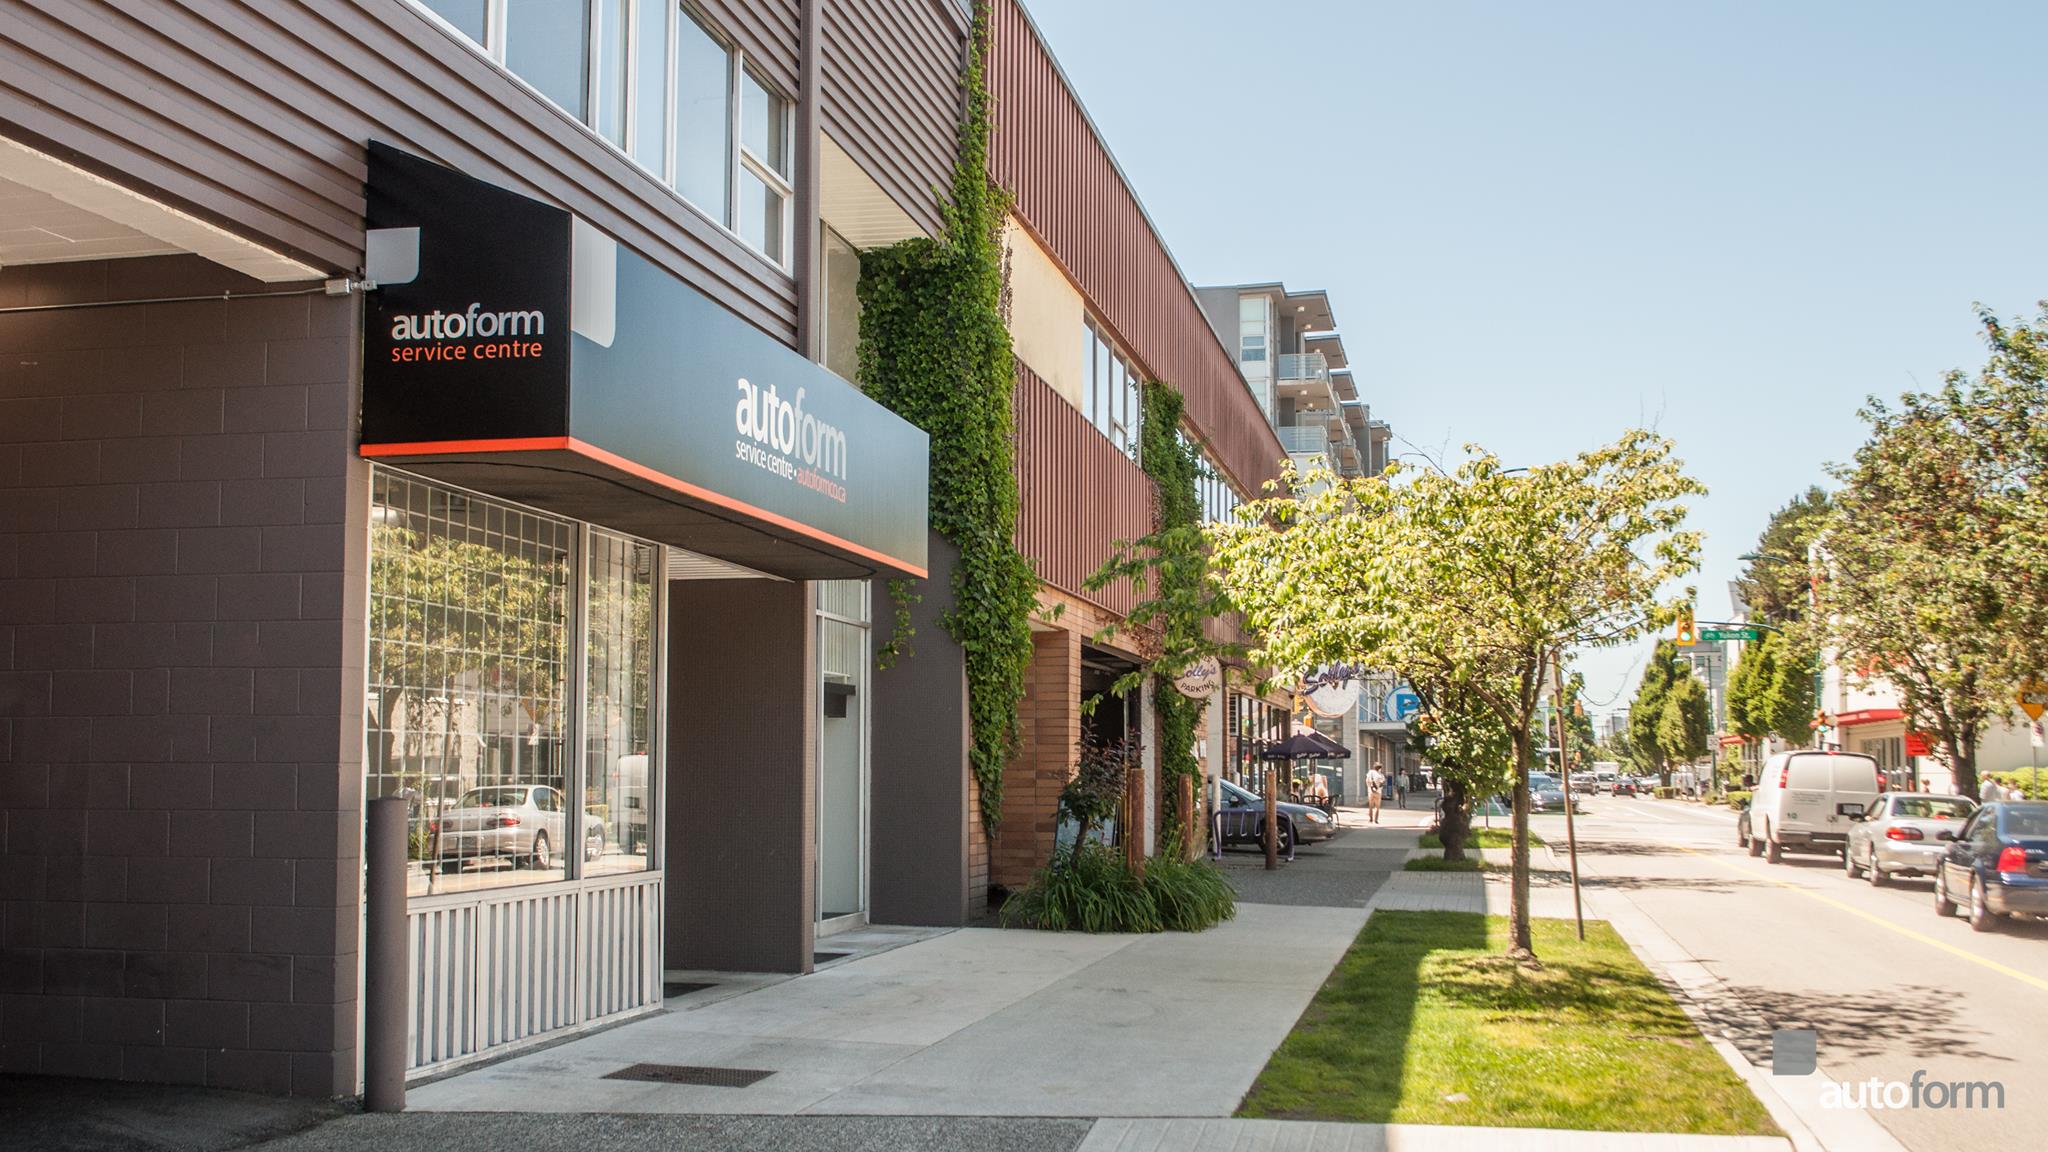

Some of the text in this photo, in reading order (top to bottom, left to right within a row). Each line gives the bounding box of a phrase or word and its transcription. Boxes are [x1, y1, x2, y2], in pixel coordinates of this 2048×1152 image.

[391, 302, 545, 341] autoform
[391, 340, 543, 362] service centre
[736, 377, 847, 481] autoform
[735, 440, 767, 469] service
[767, 453, 793, 480] centre
[1180, 680, 1216, 693] PARKING
[1302, 660, 1359, 695] Sollys
